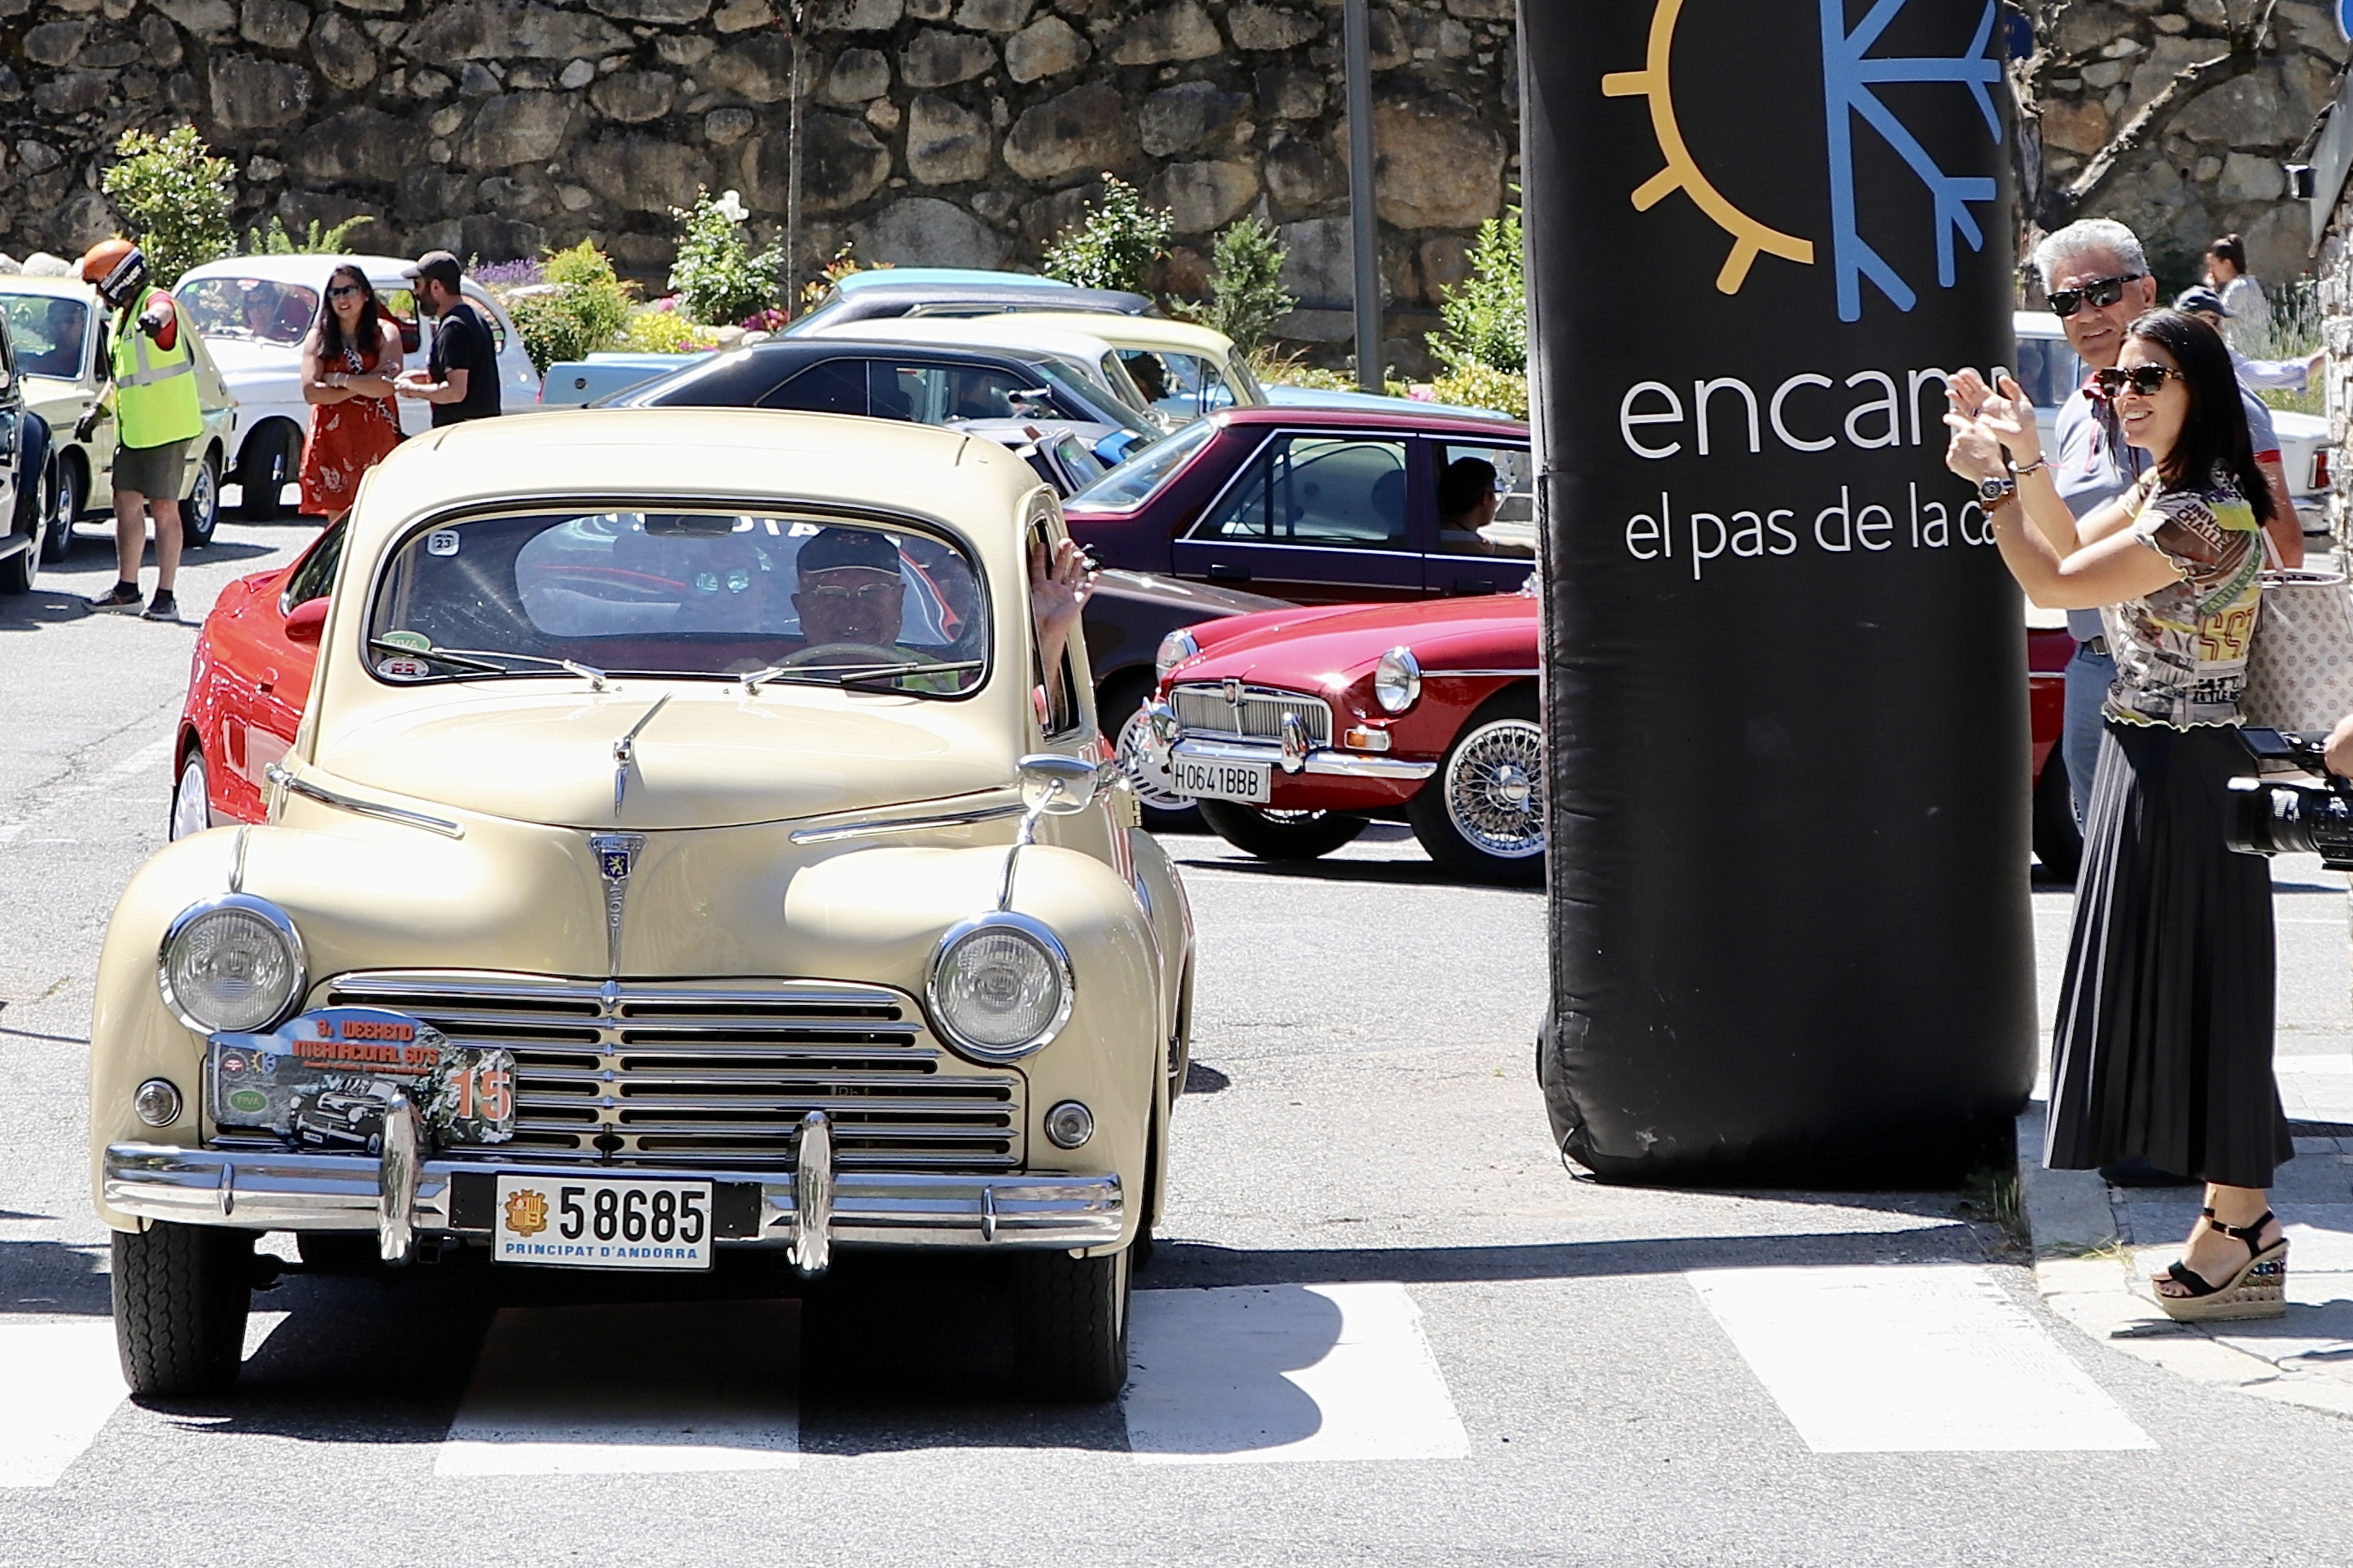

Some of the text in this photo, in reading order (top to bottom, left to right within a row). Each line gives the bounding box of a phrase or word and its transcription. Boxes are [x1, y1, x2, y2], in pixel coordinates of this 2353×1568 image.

[1620, 365, 2012, 460] encam
[436, 539, 451, 548] 23
[1625, 491, 1672, 559] el
[1691, 509, 1798, 580] pas
[1814, 485, 1894, 552] de
[1909, 482, 1949, 548] la
[2202, 582, 2241, 614] EARTH
[341, 1020, 414, 1042] WEEKEND
[292, 1041, 400, 1064] INTERNACIONAL
[237, 1096, 260, 1106] FIVA
[451, 1068, 513, 1122] 15
[559, 1186, 706, 1244] 58685
[505, 1243, 698, 1259] PRINCIPAT D'ANDORRA
